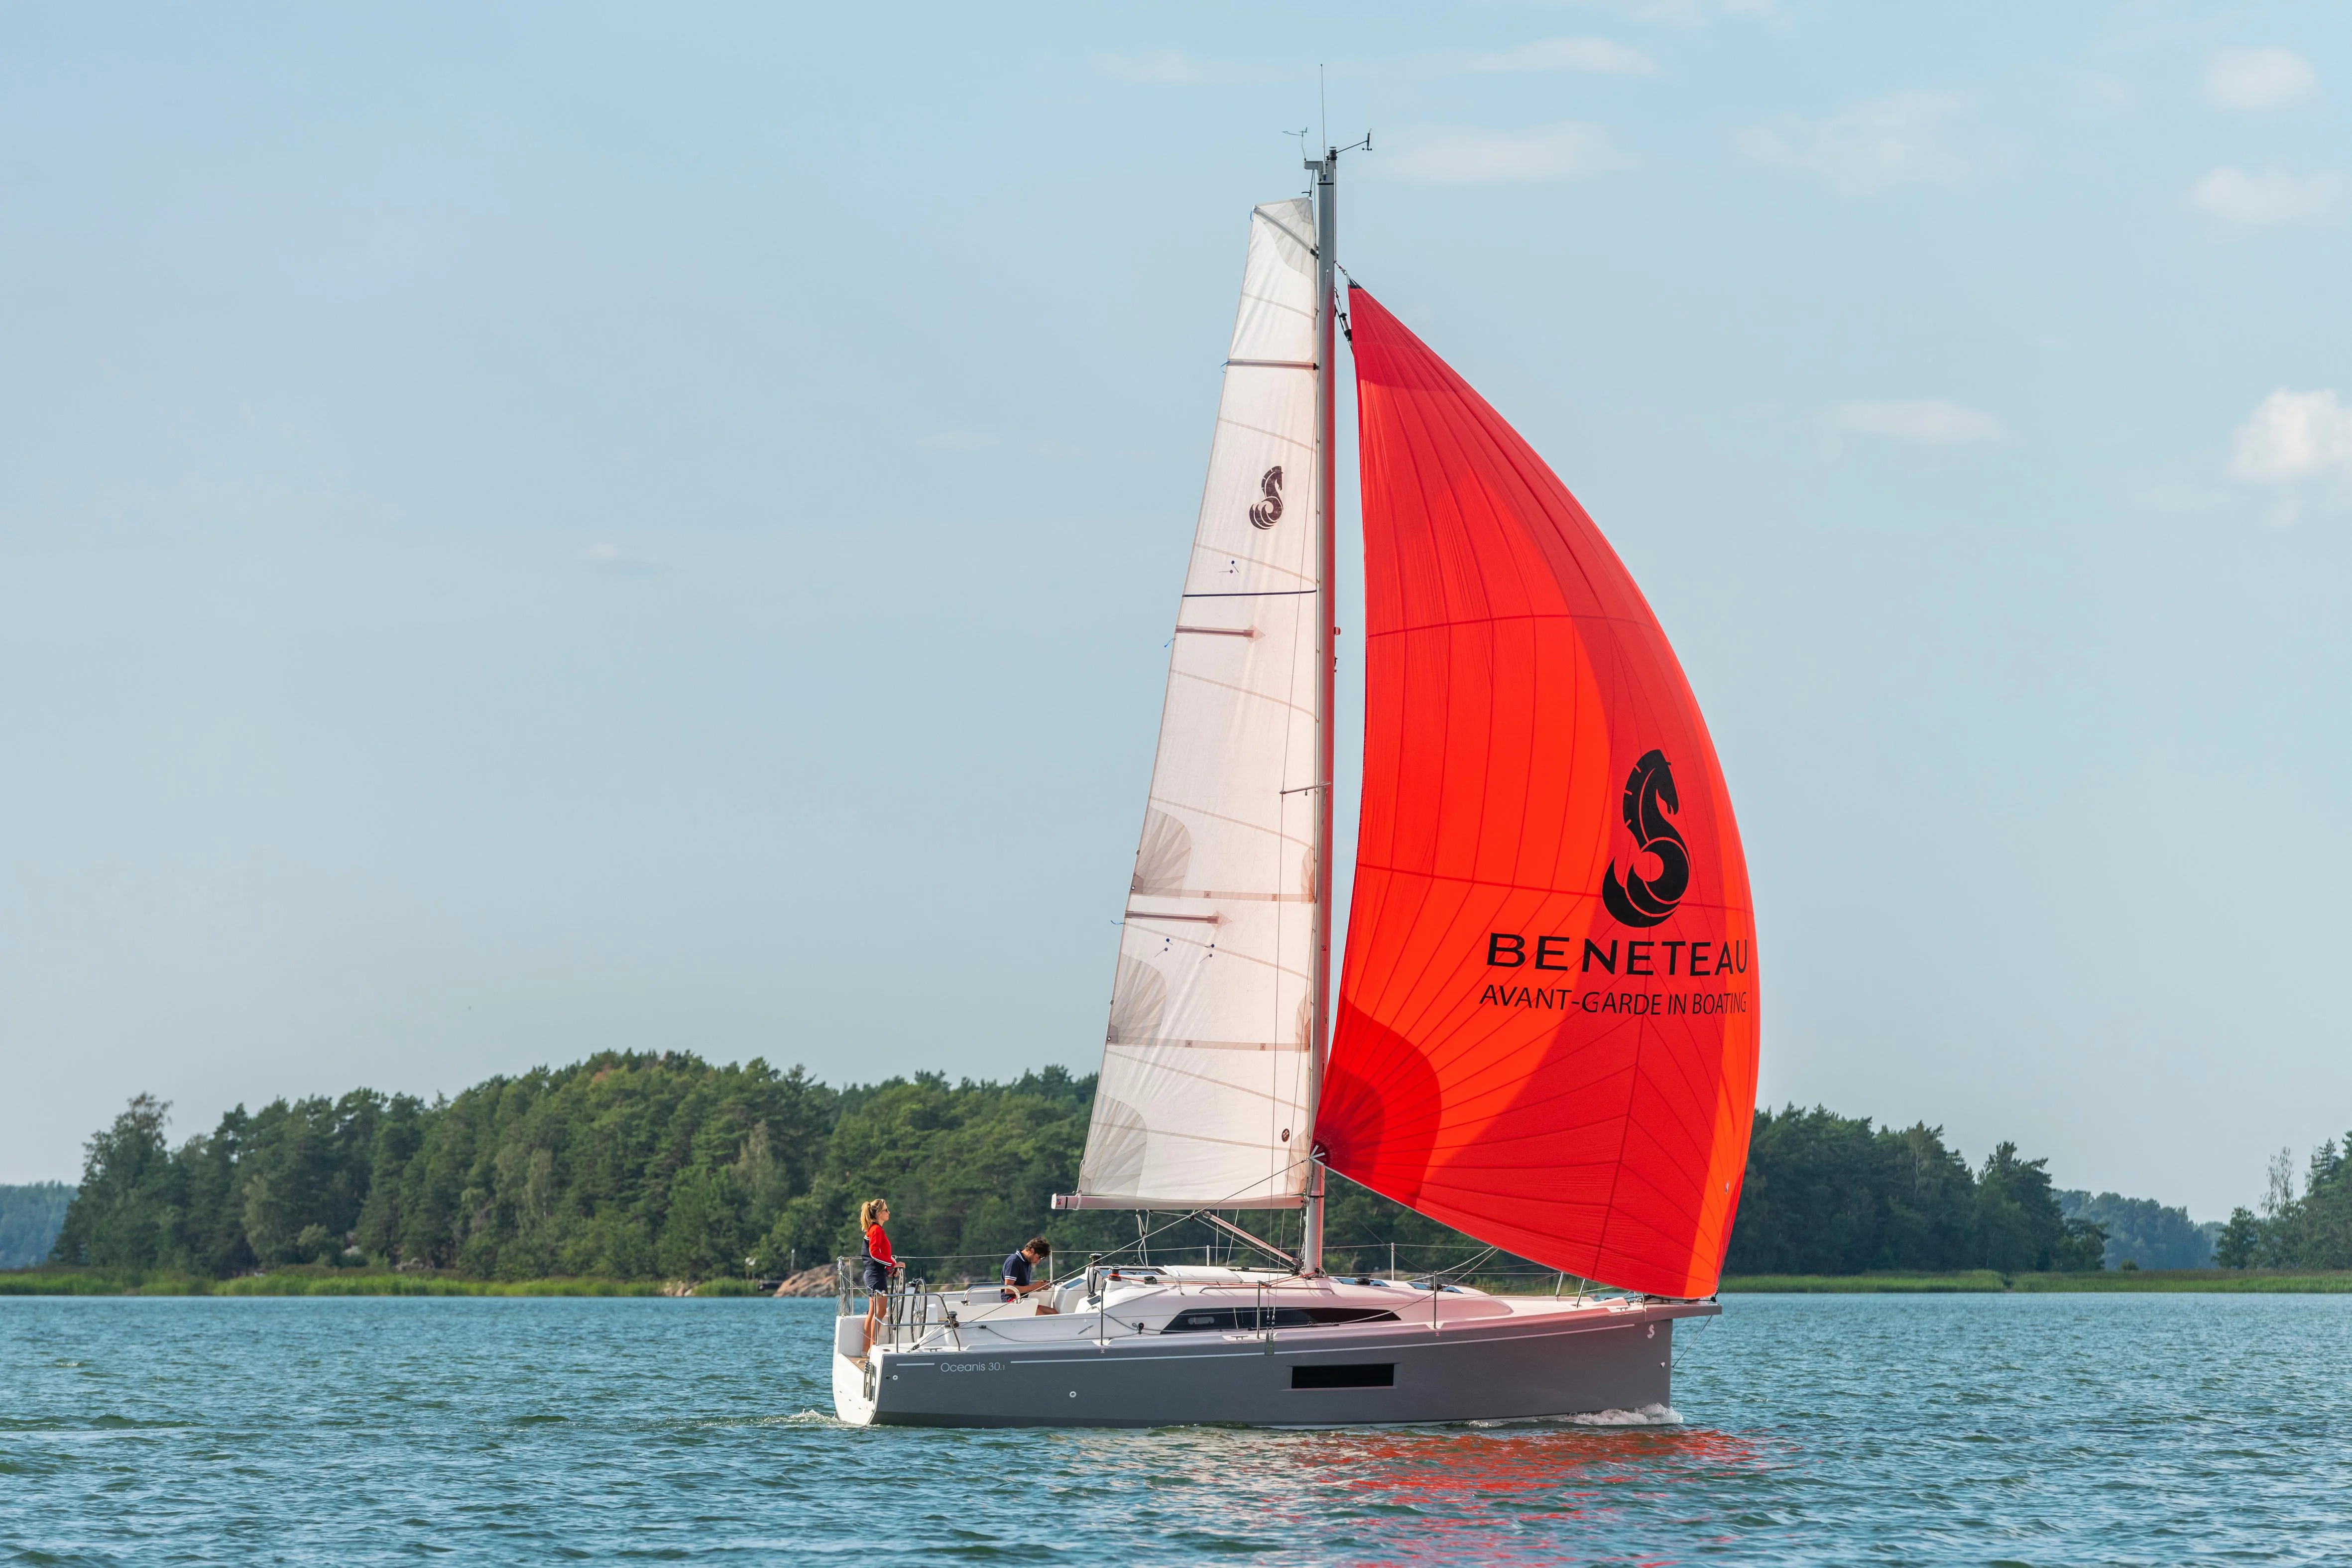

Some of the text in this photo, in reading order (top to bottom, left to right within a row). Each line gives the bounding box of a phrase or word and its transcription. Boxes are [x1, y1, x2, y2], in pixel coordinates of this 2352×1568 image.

[1487, 932, 1747, 976] BENETEAU
[1479, 984, 1747, 1015] AVANT-GARDE IN BOATING
[941, 1362, 1005, 1372] Oceanis 30.1
